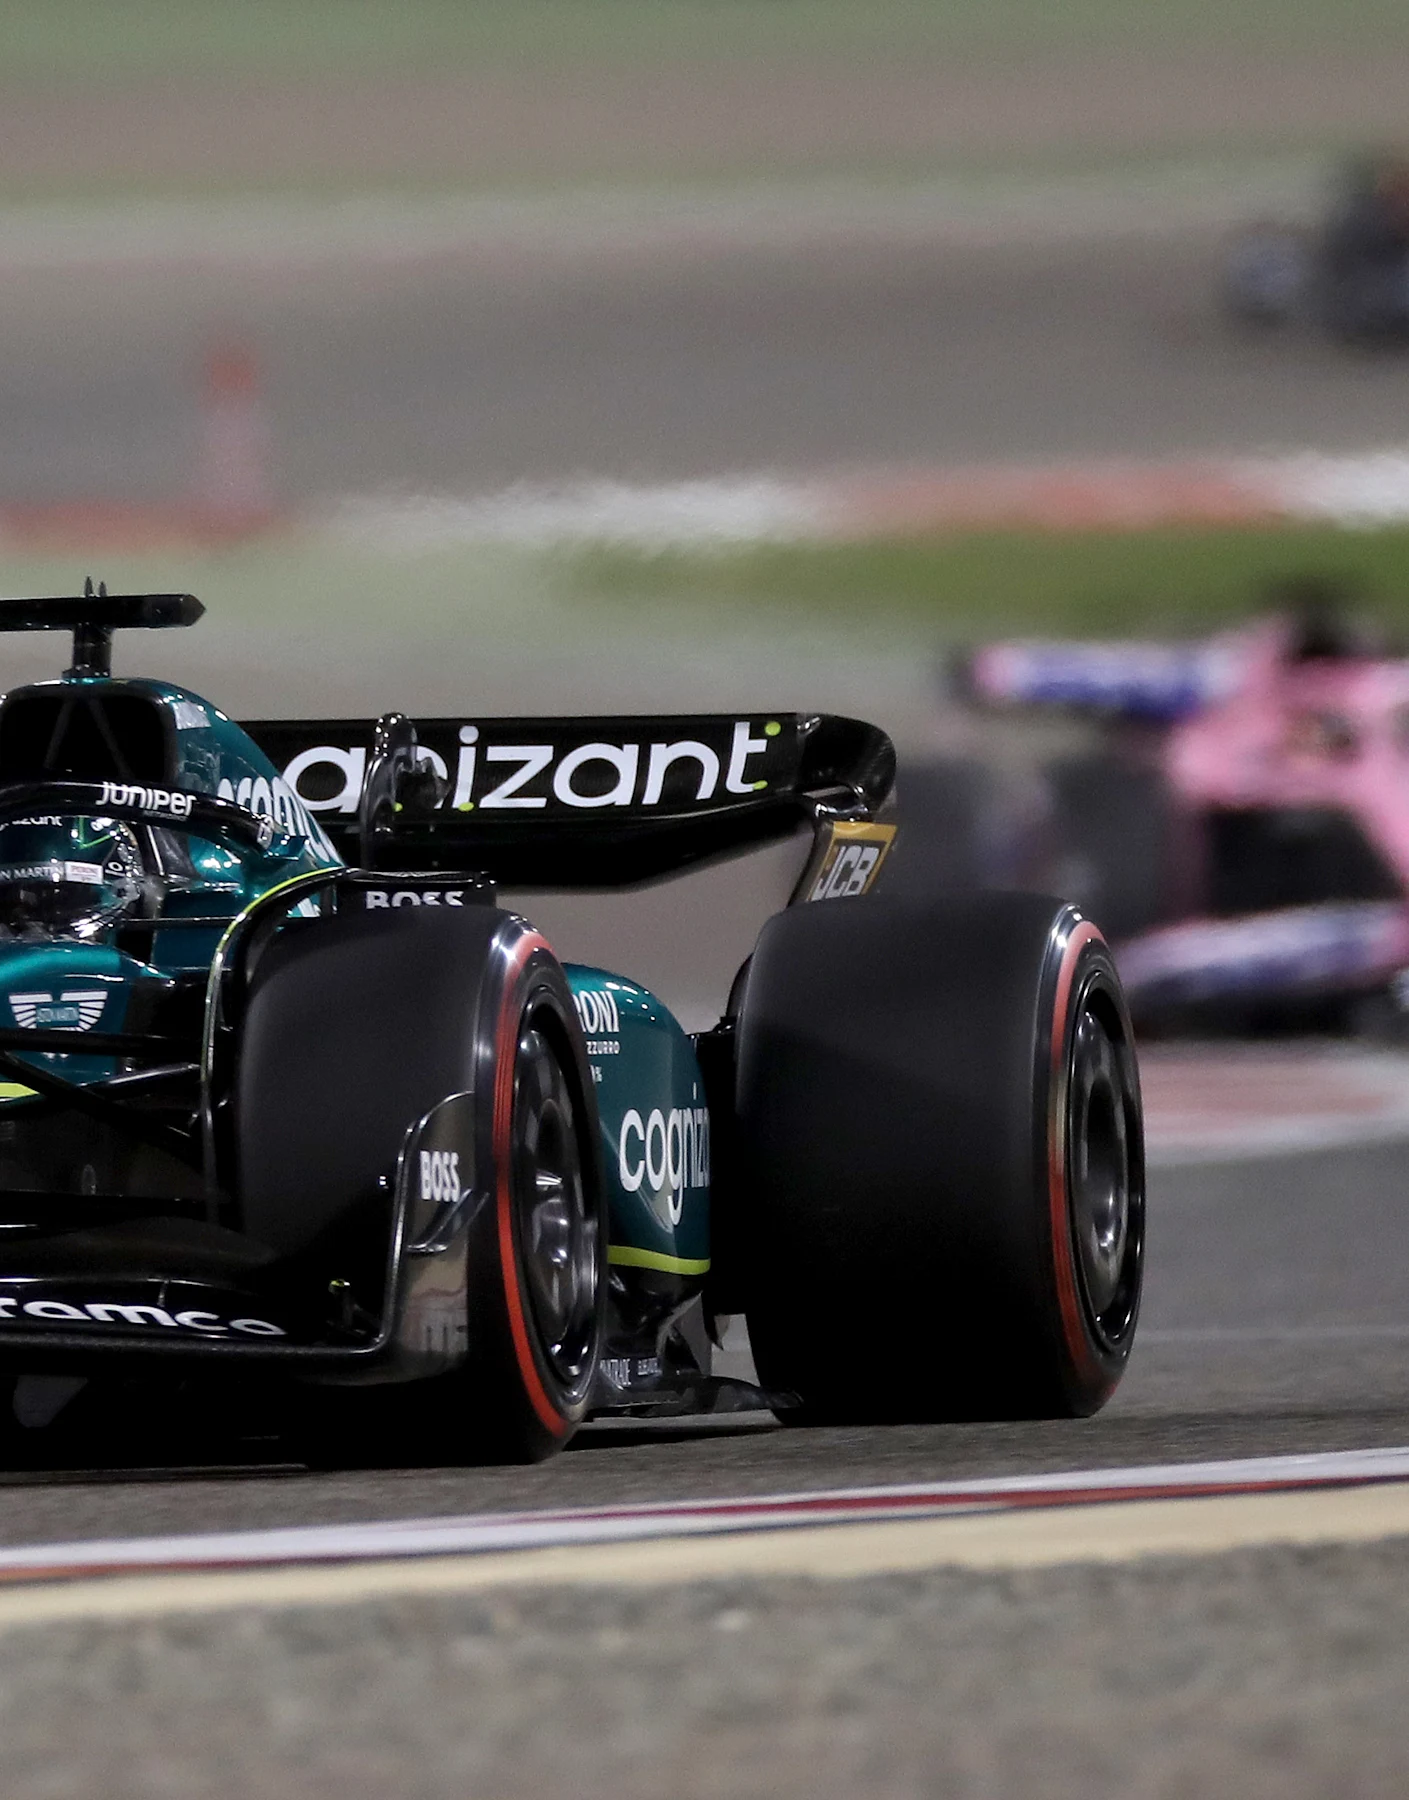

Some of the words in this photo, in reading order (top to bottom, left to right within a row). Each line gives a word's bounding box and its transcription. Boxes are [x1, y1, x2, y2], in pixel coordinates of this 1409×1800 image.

[811, 845, 880, 902] JCB
[366, 890, 464, 910] BOSS
[420, 1150, 460, 1202] BOSS
